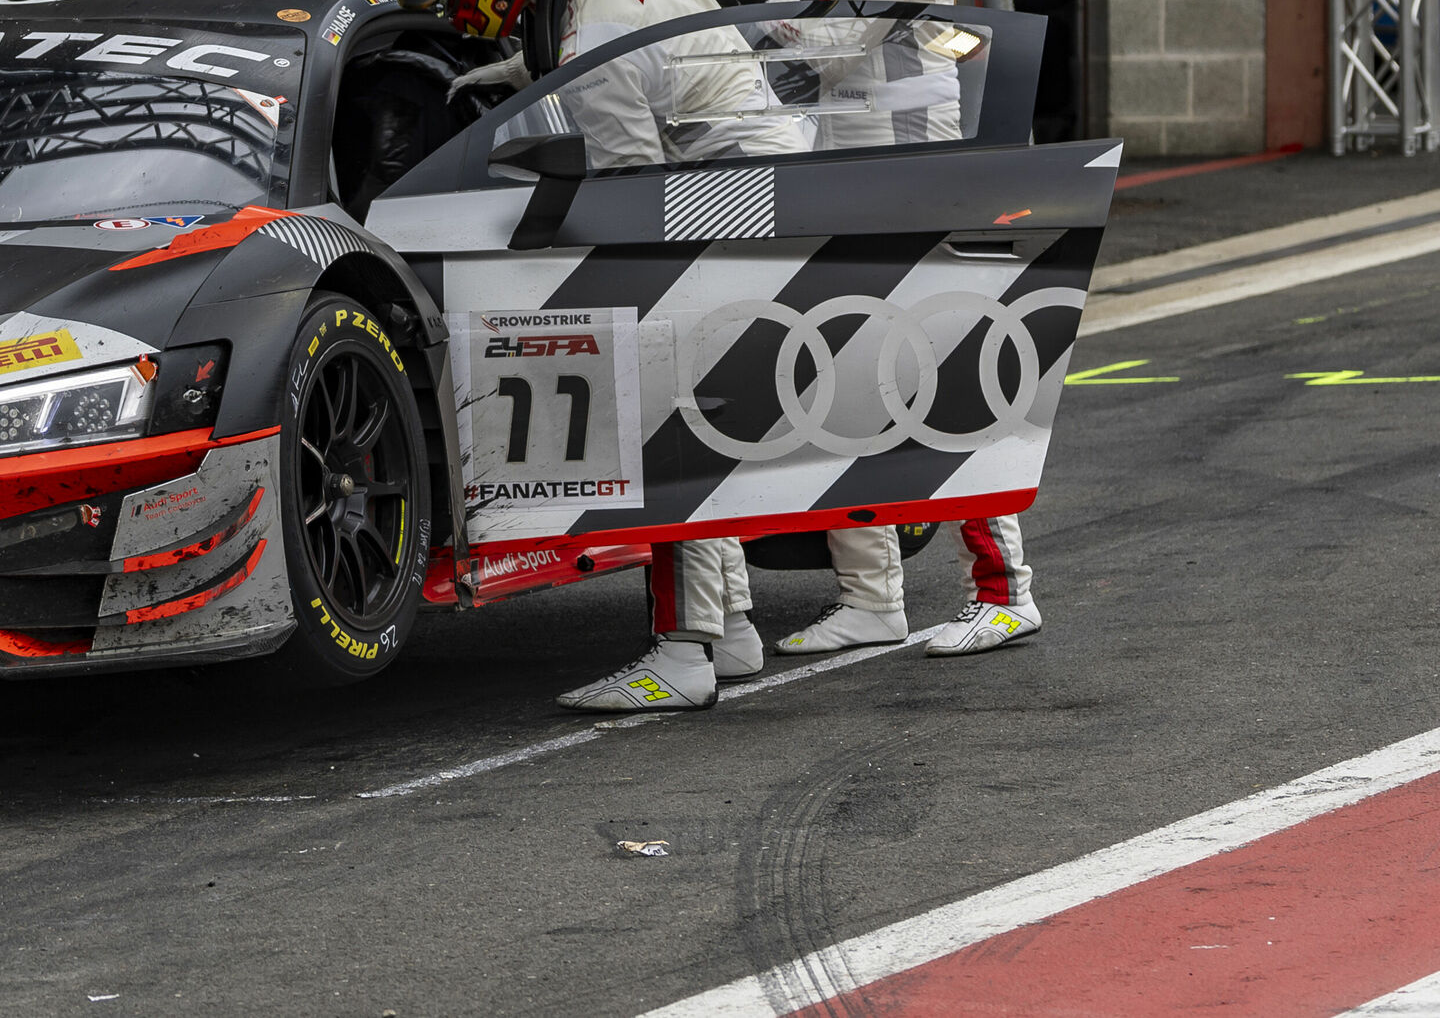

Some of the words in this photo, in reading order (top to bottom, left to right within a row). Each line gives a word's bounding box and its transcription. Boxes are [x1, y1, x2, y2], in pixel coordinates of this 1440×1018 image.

[329, 5, 357, 37] HAASE
[837, 89, 868, 100] HAASE
[111, 220, 134, 229] E
[488, 314, 592, 327] CROWDSTRIKE
[335, 309, 348, 327] P
[352, 311, 405, 373] ZERO
[497, 374, 592, 464] 11
[143, 497, 168, 513] Audi
[168, 486, 199, 504] Sport
[464, 479, 631, 501] #FANATECGT
[483, 552, 519, 579] Audi
[517, 548, 561, 573] Sport
[310, 597, 379, 660] PIRELLI
